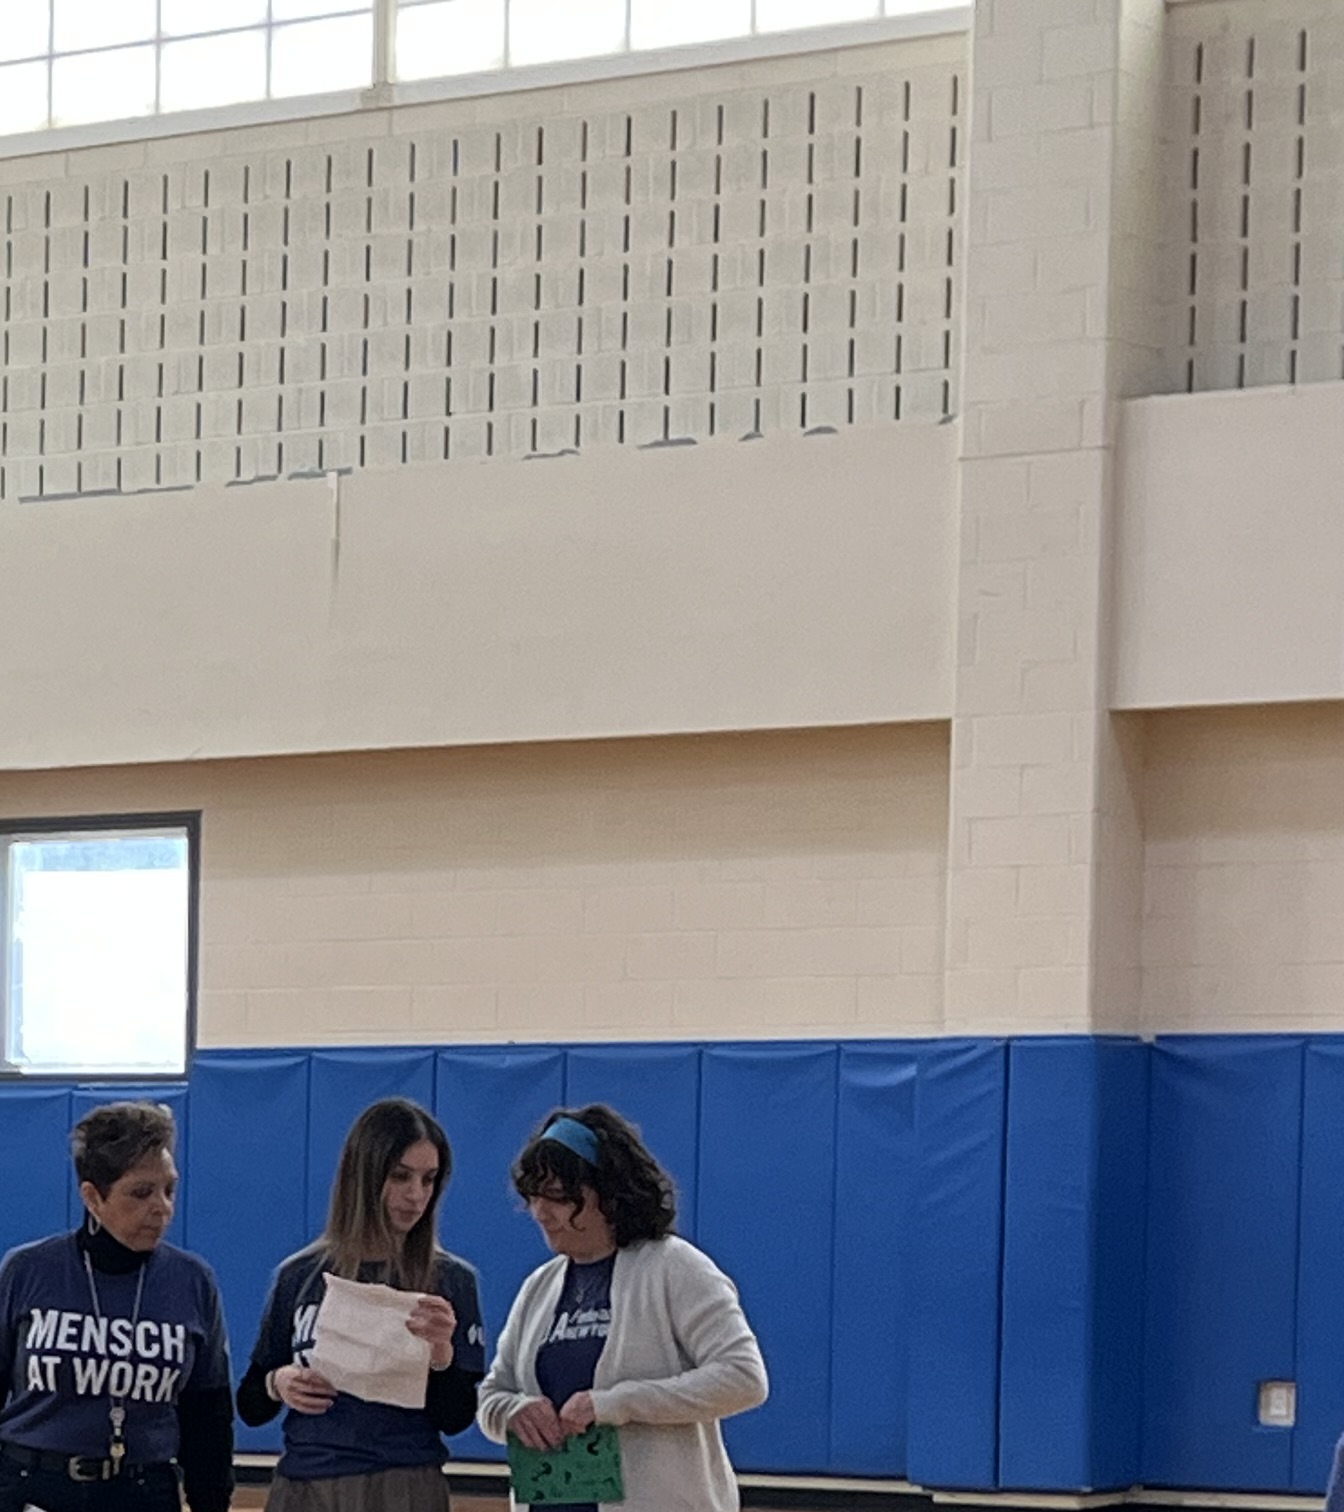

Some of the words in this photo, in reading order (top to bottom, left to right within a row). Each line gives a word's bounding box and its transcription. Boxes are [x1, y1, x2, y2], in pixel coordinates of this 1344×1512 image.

[25, 1307, 186, 1364] MENSCH
[26, 1354, 62, 1393] AT
[72, 1357, 183, 1403] WORK
